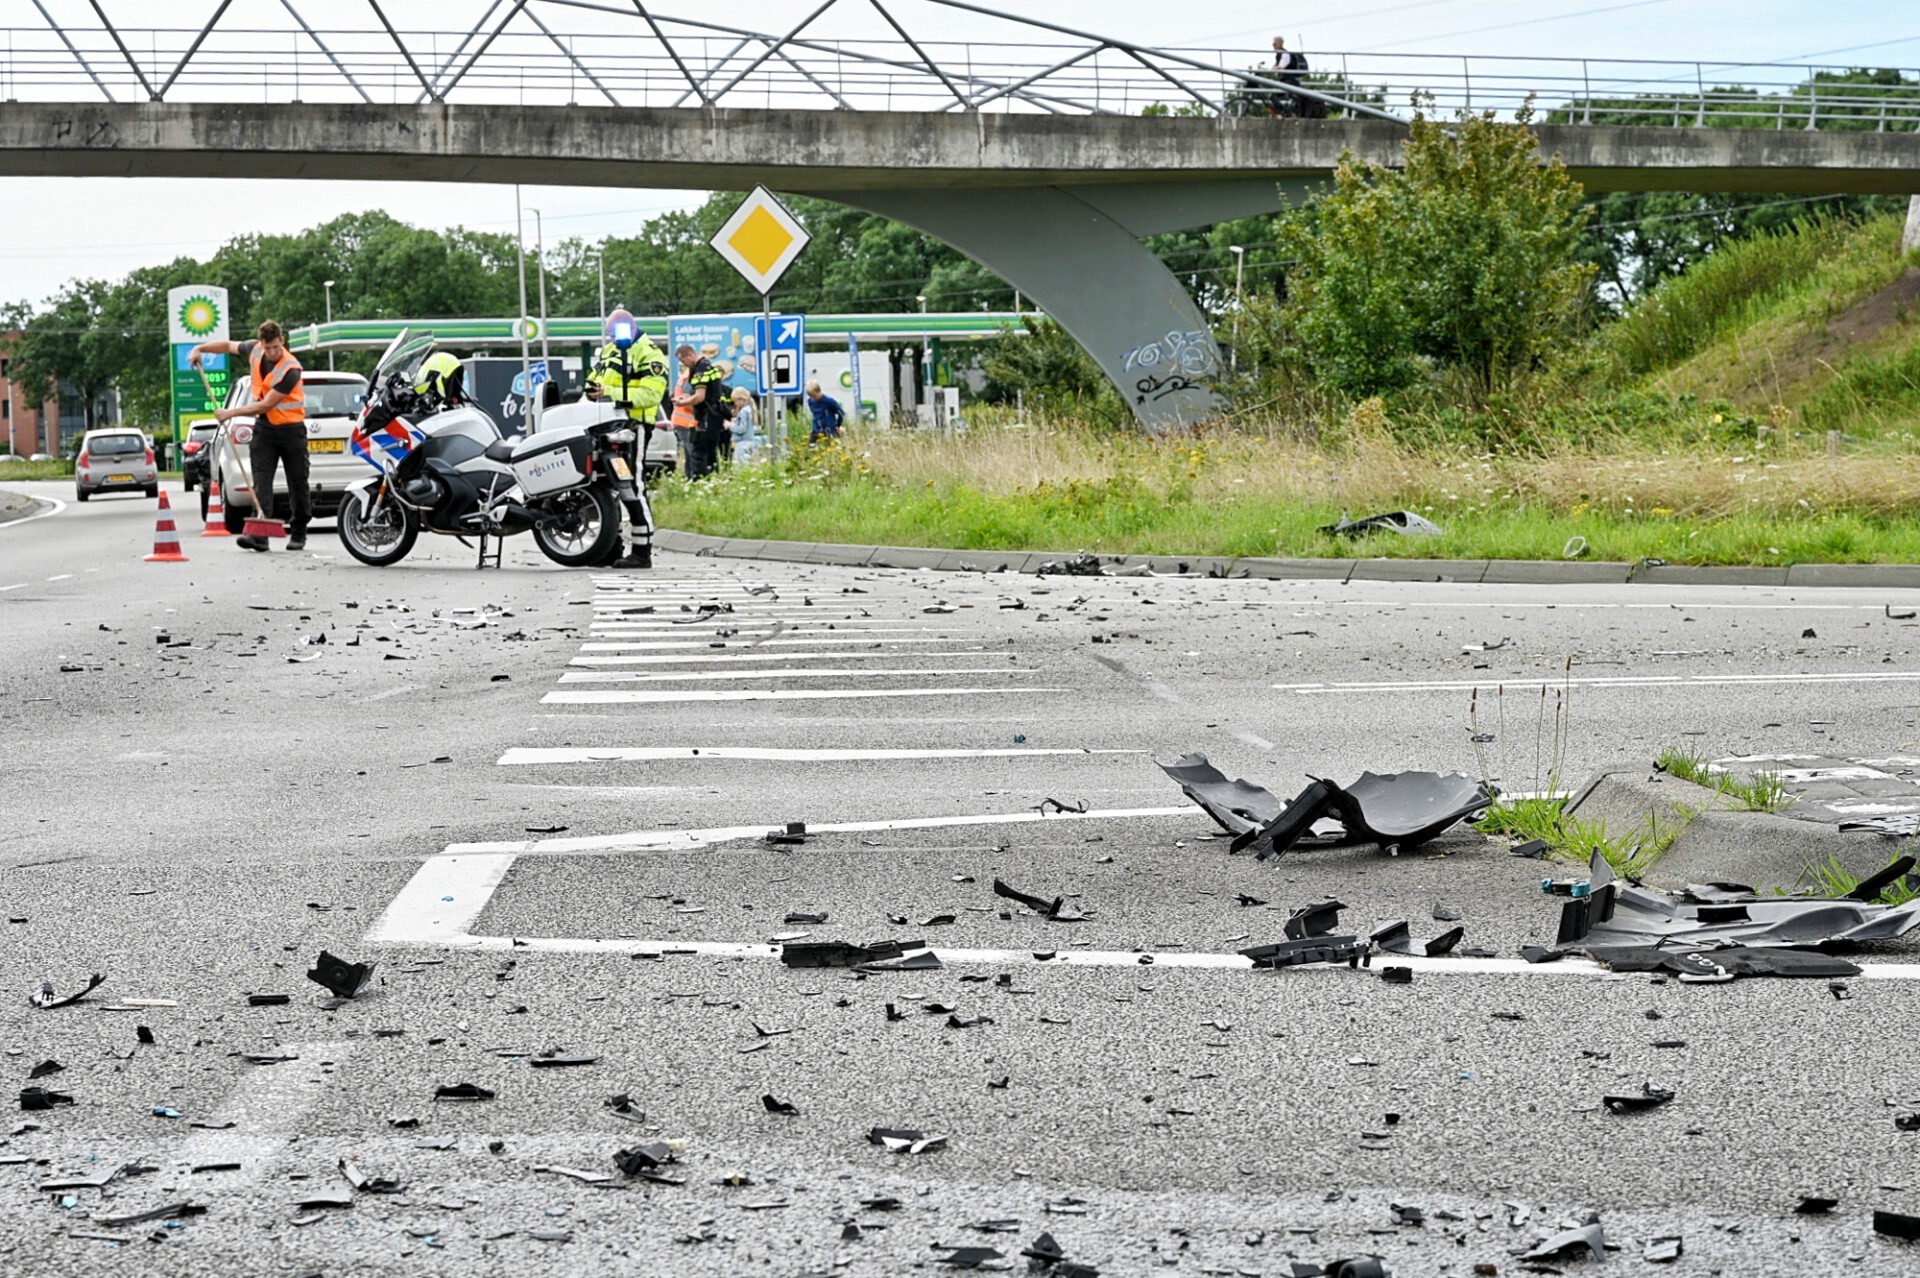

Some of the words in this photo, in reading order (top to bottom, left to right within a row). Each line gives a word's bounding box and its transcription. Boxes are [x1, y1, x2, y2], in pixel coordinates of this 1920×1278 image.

[209, 289, 222, 298] bp
[675, 325, 701, 334] Lekker
[528, 459, 567, 478] POLITIE
